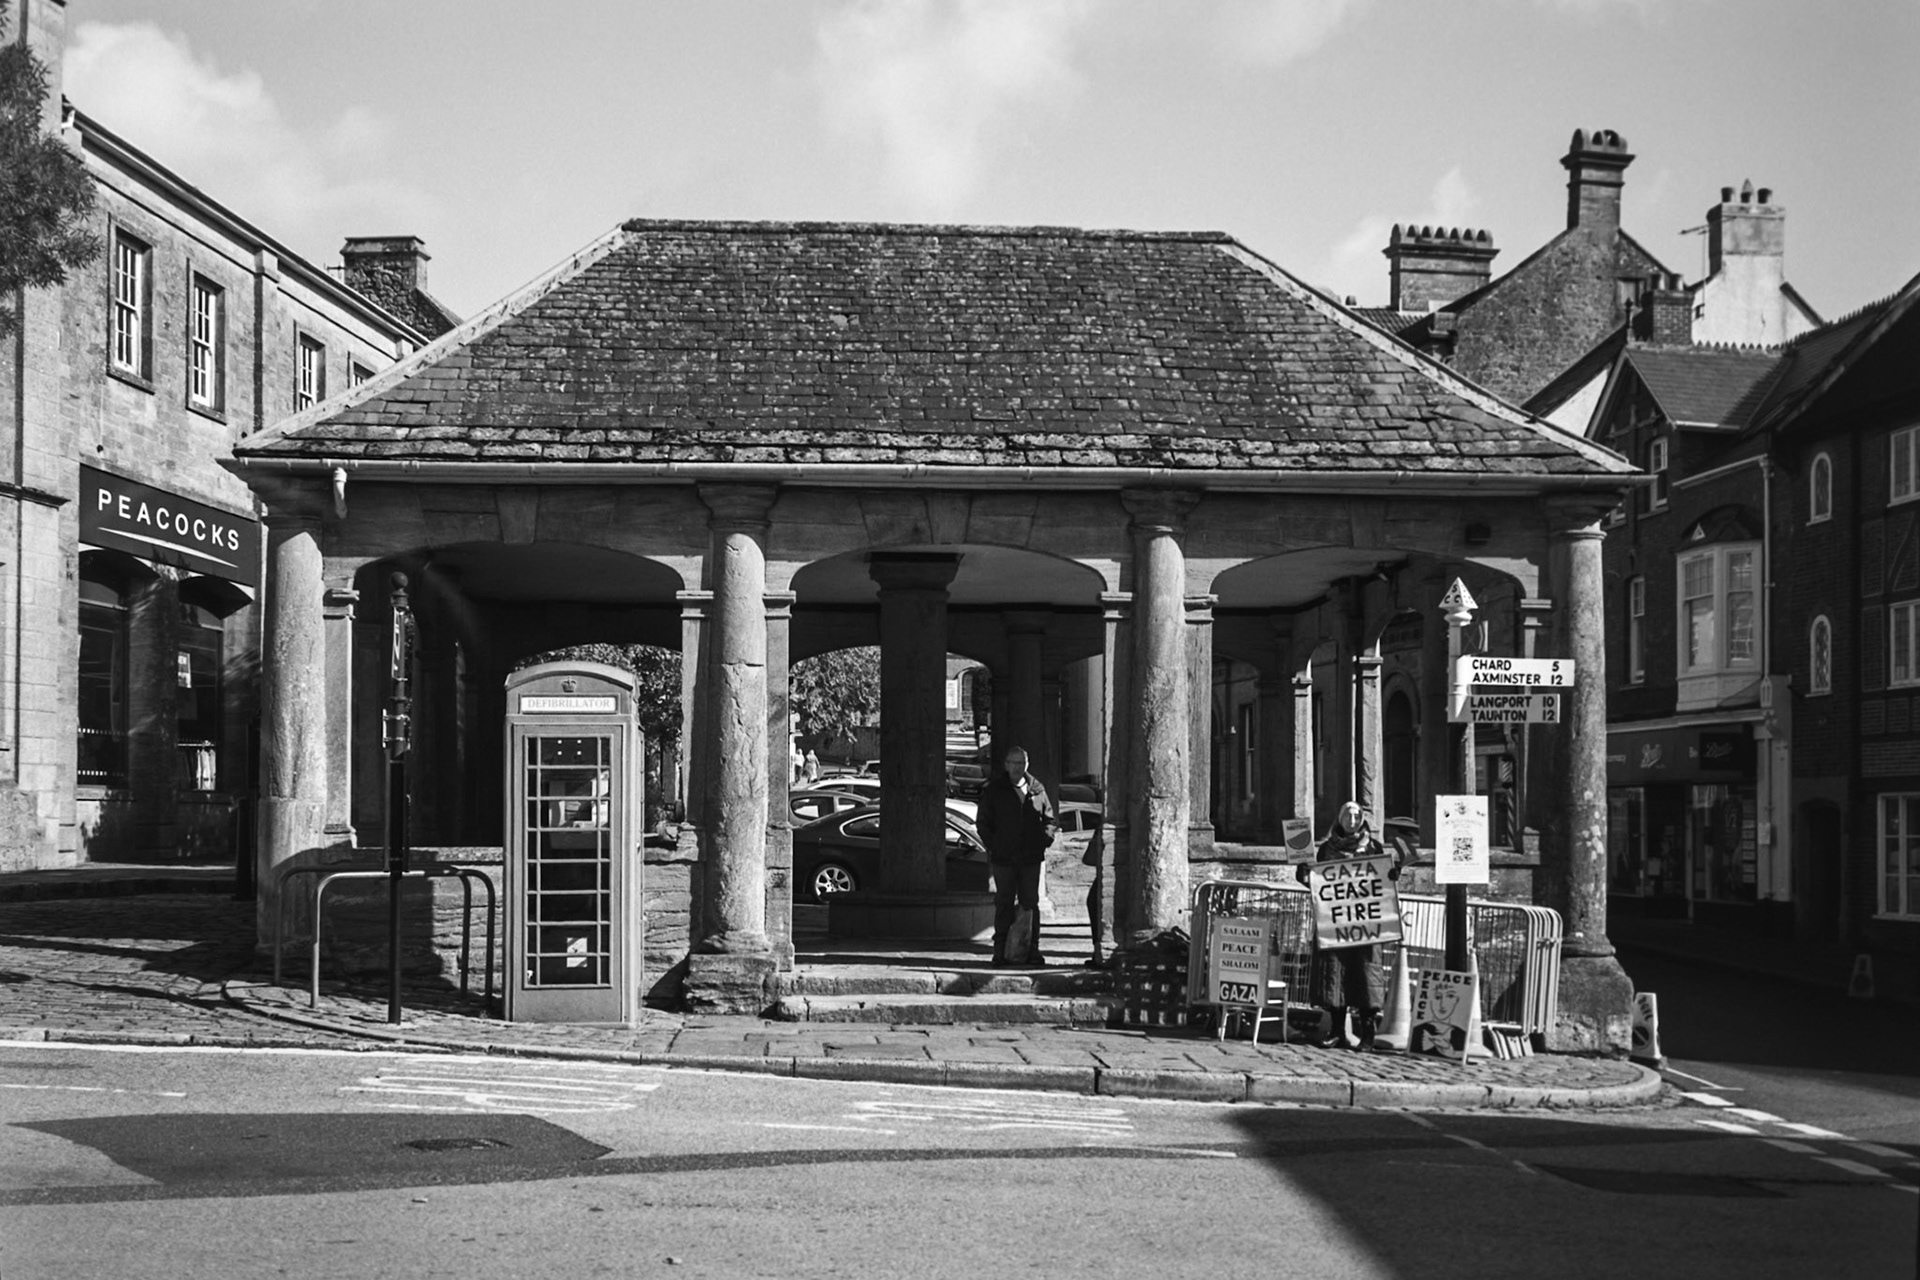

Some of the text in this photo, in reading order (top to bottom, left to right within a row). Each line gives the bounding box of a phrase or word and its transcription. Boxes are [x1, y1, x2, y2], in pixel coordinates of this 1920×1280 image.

[98, 488, 239, 550] PEACOCKS
[1472, 659, 1560, 672] CHARD 5
[1472, 672, 1563, 685] AXMINSTER 12
[528, 698, 610, 709] DEFIBRILLATOR
[1470, 696, 1555, 708] LANGPORT 10
[1471, 709, 1555, 721] TAUNTON 12
[1322, 861, 1378, 882] GAZA
[1319, 879, 1383, 901] CEASE
[1331, 901, 1381, 924] FIRE
[1223, 927, 1260, 937] SALAAM
[1335, 923, 1381, 943] NOW
[1222, 942, 1258, 954] PEACE
[1222, 960, 1259, 970] SHALOM
[1423, 970, 1472, 985] PEACE
[1220, 983, 1257, 1003] GAZA
